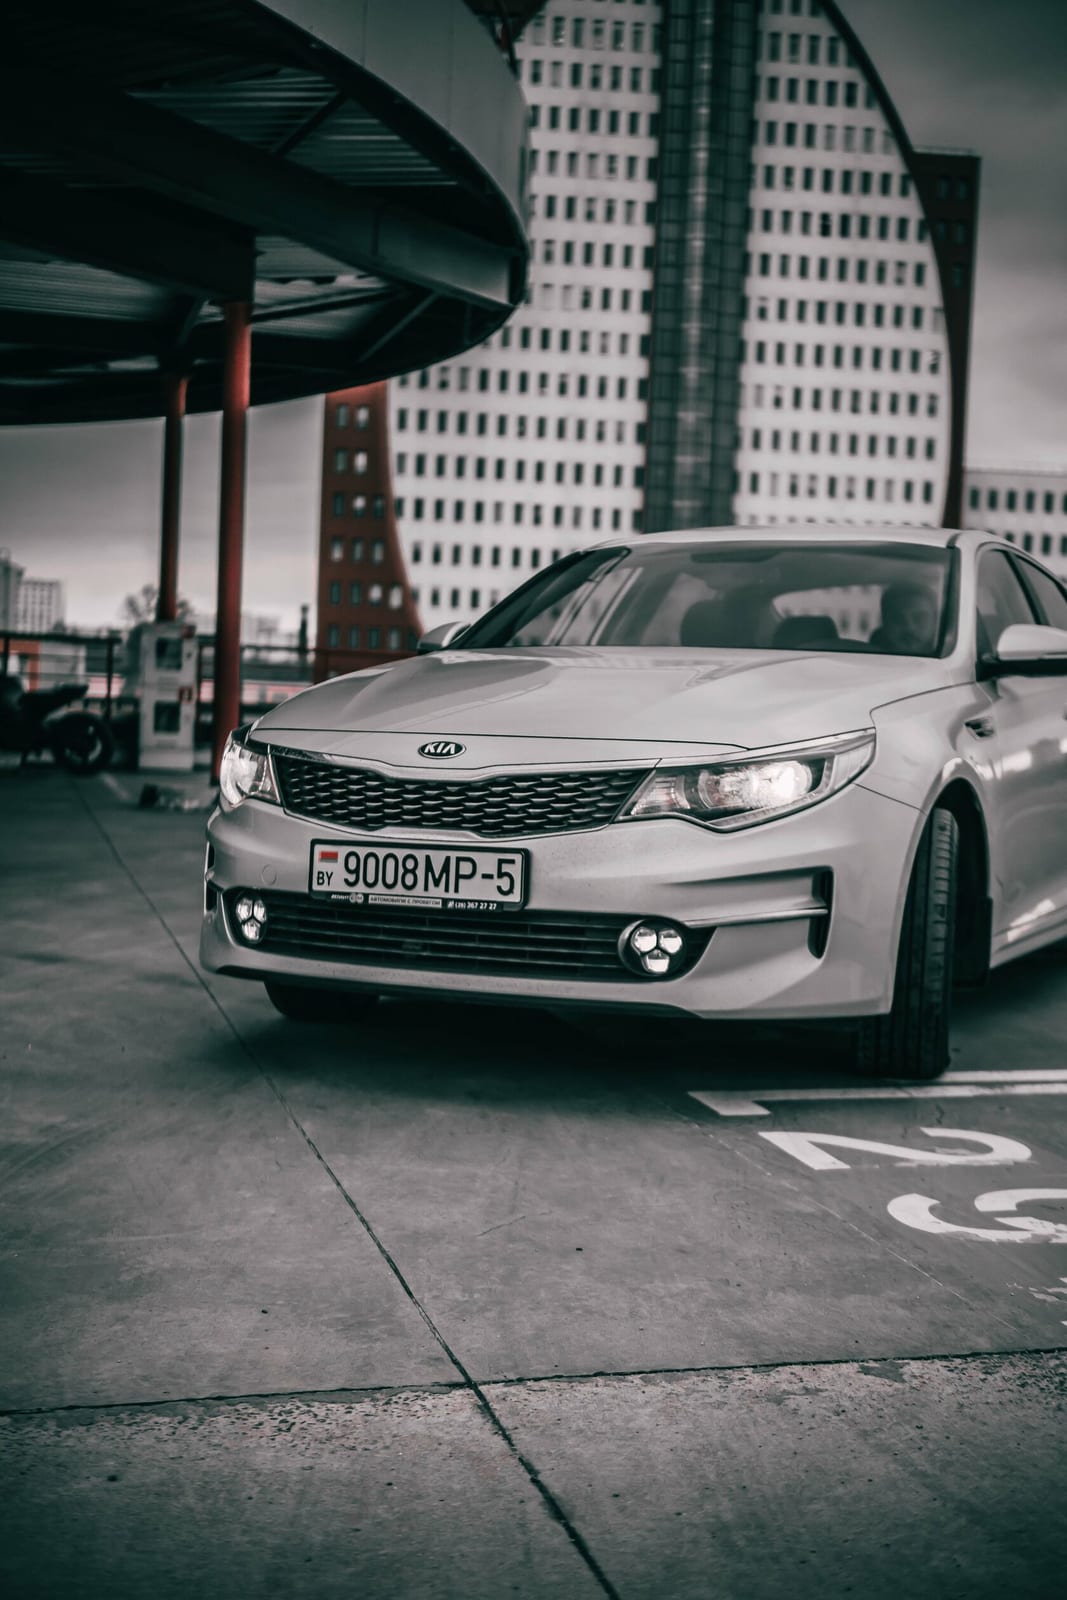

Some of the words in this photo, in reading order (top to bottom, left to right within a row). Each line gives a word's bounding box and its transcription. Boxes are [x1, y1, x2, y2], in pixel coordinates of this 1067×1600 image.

[423, 742, 456, 755] KIA
[316, 870, 334, 887] BY
[343, 850, 516, 897] 9008MP-5
